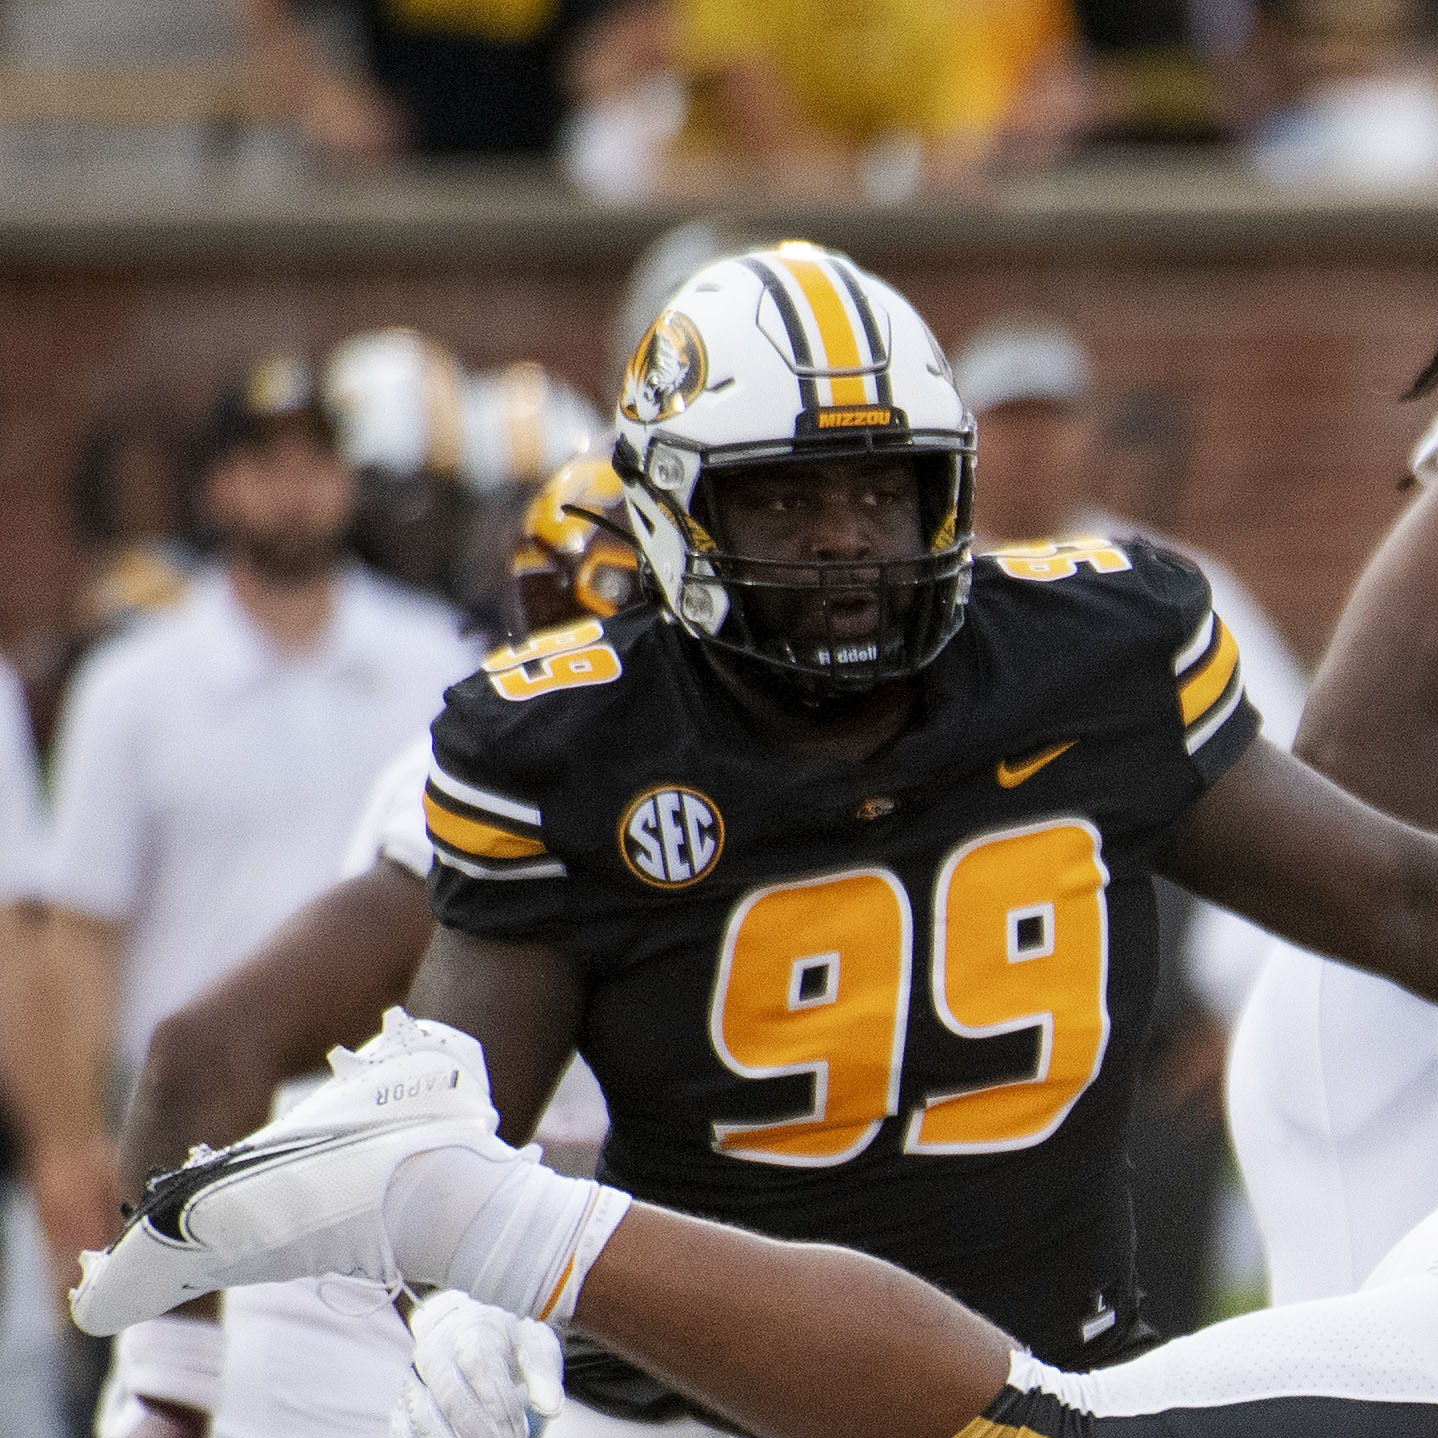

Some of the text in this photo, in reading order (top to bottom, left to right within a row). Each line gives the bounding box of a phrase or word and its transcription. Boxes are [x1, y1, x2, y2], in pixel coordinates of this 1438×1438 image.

[816, 409, 891, 429] MIZZOU
[817, 645, 878, 665] Rddell
[628, 791, 717, 881] SEC
[710, 817, 1111, 1169] 99
